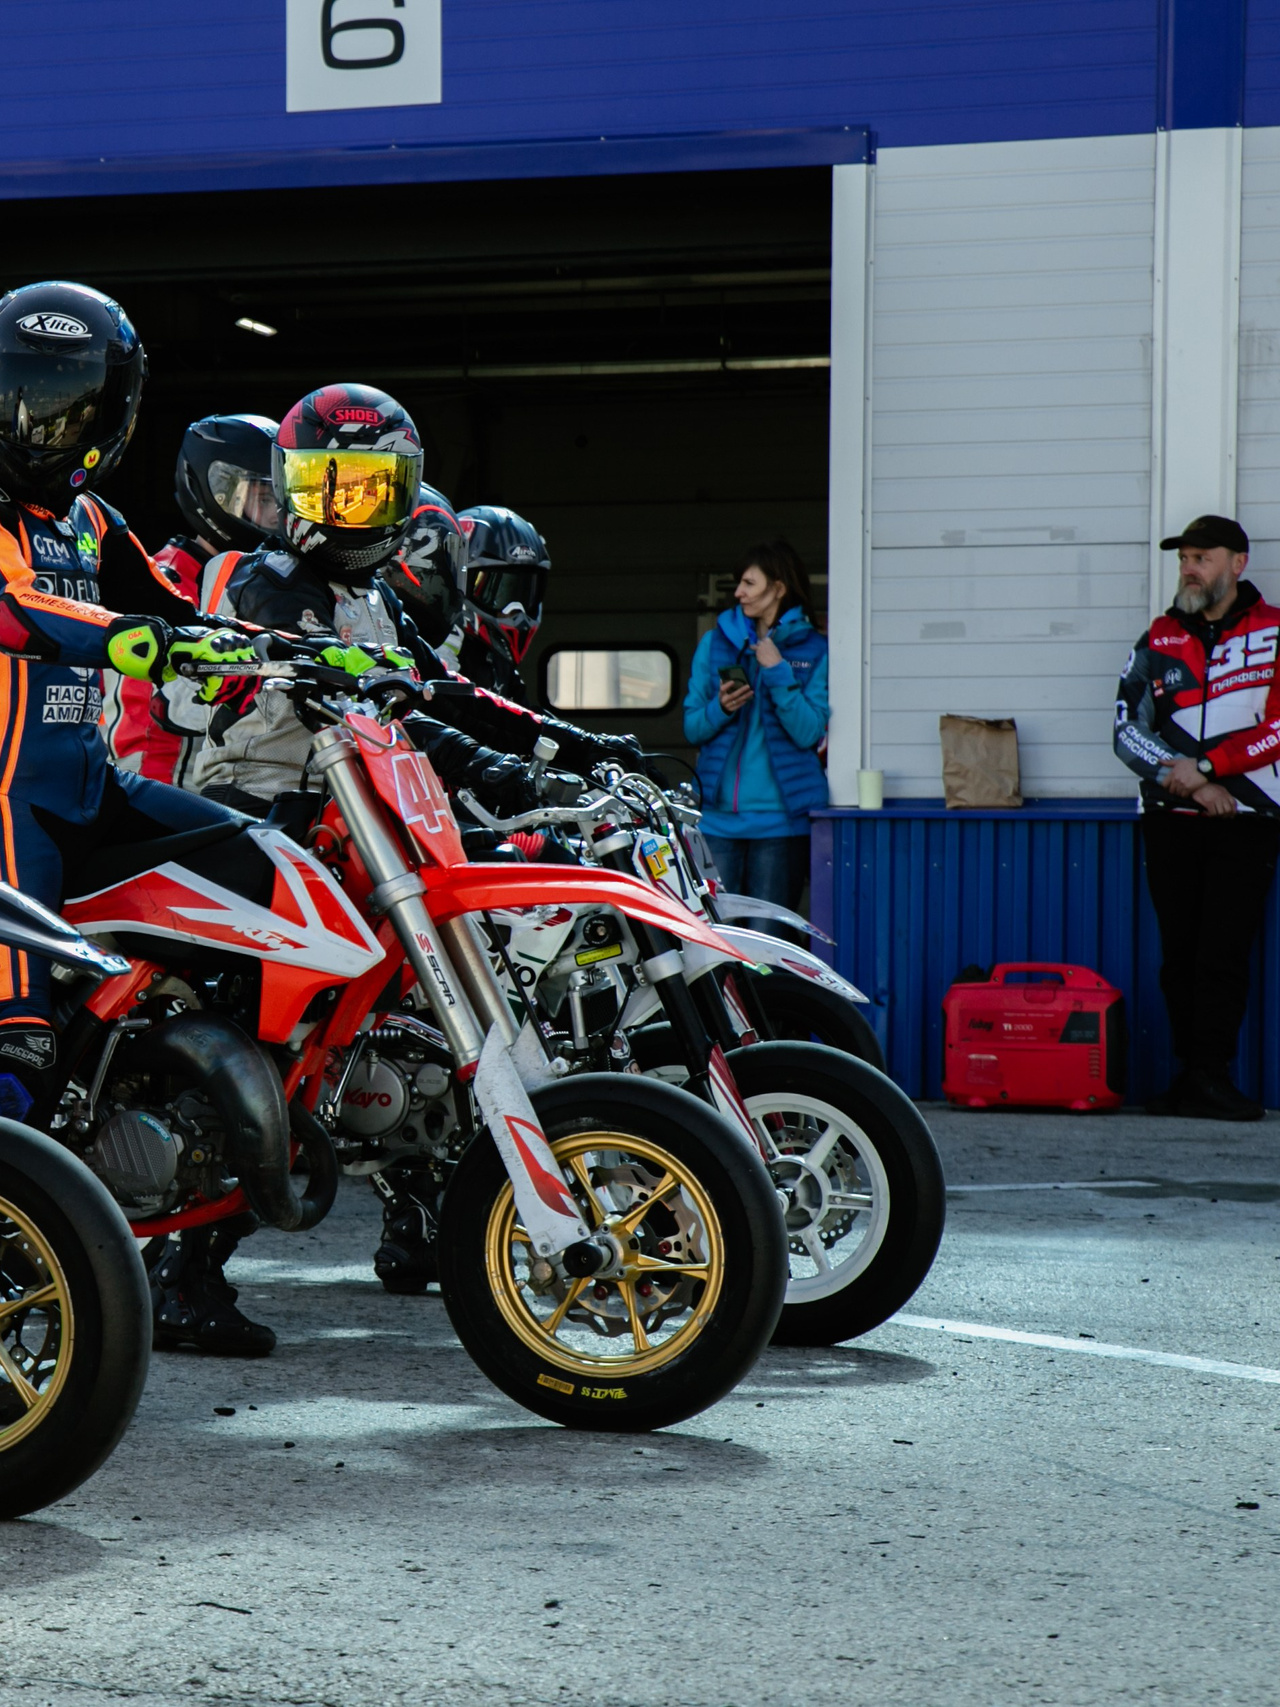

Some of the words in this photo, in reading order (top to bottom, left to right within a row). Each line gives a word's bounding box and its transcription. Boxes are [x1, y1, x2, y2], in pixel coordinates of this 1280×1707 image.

[321, 0, 405, 70] 6
[335, 409, 378, 423] SHOEI
[1208, 626, 1280, 681] 35
[426, 954, 456, 1006] SCAR
